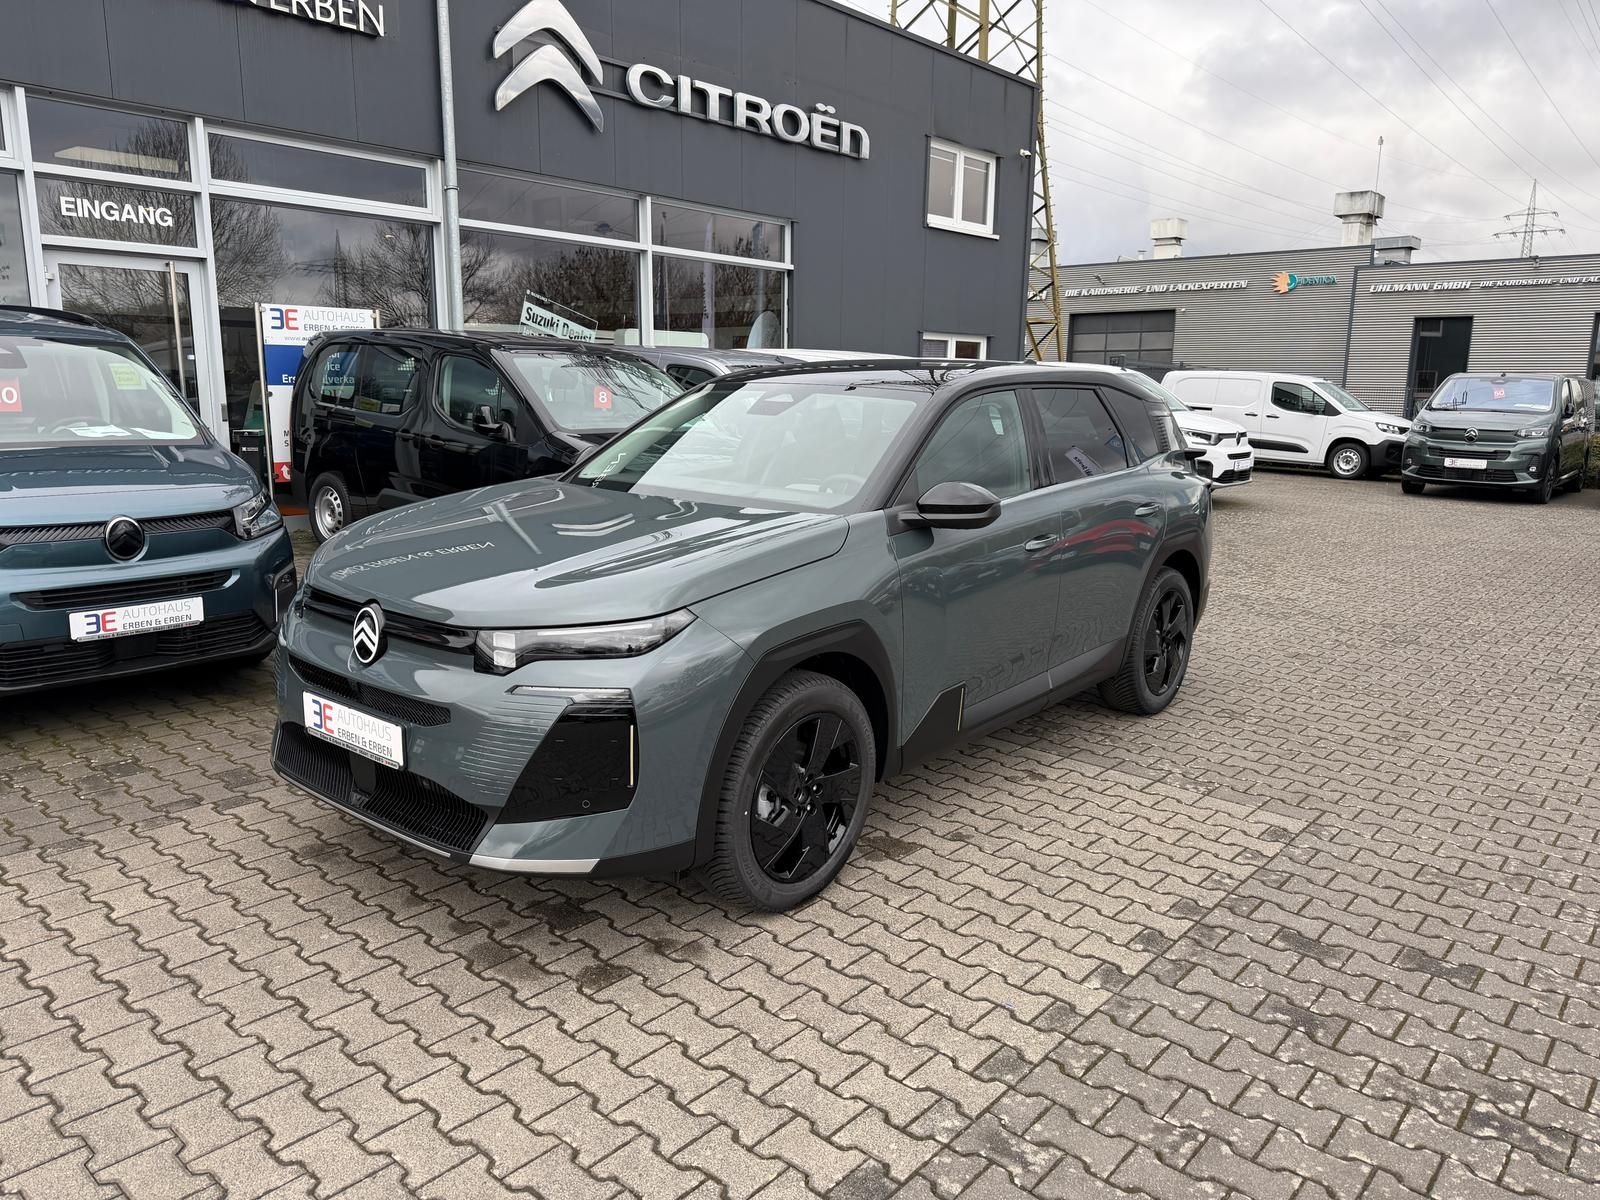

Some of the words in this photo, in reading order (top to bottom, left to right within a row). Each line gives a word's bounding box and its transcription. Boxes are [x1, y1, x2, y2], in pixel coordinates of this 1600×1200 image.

[59, 195, 174, 228] EINGANG
[1369, 281, 1430, 293] UHLMANN
[303, 309, 366, 323] AUTOHAUS
[524, 306, 560, 333] Suzuki
[599, 391, 608, 403] 8
[122, 601, 192, 620] AUTOHAUS
[122, 618, 153, 630] ERBEN
[154, 618, 162, 626] &
[163, 613, 192, 624] ERBEN
[337, 708, 392, 742] AUTOHAUS
[337, 727, 360, 745] ERBEN
[368, 739, 393, 758] ERBEN
